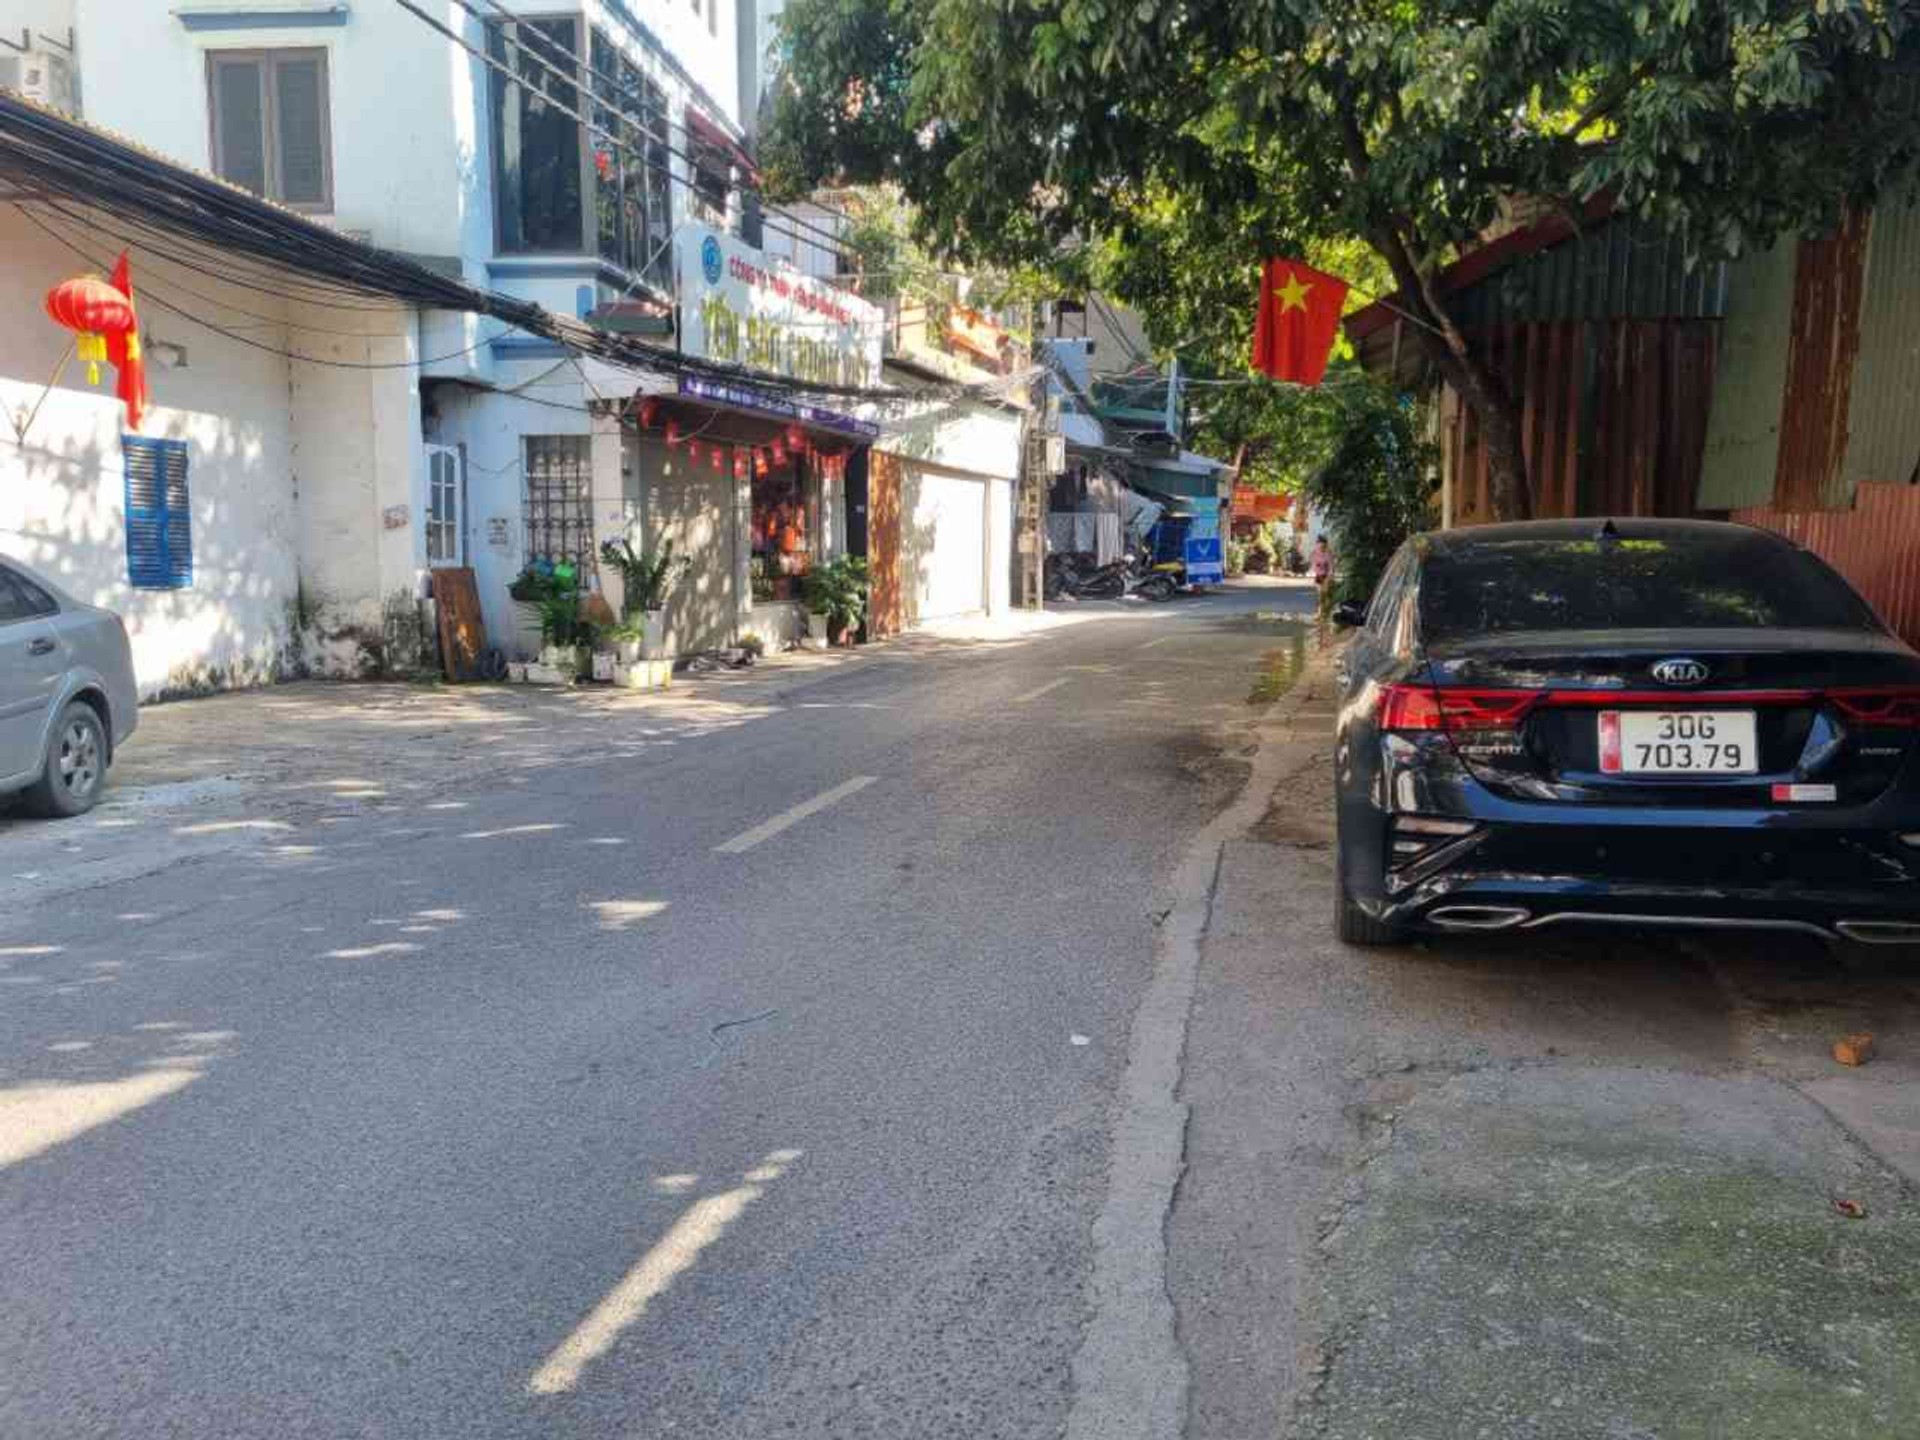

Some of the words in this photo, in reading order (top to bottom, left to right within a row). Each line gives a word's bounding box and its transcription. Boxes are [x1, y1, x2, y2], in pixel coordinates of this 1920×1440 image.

[1662, 664, 1701, 681] KIA
[1657, 714, 1716, 740] 30G
[1634, 744, 1742, 769] 703.79
